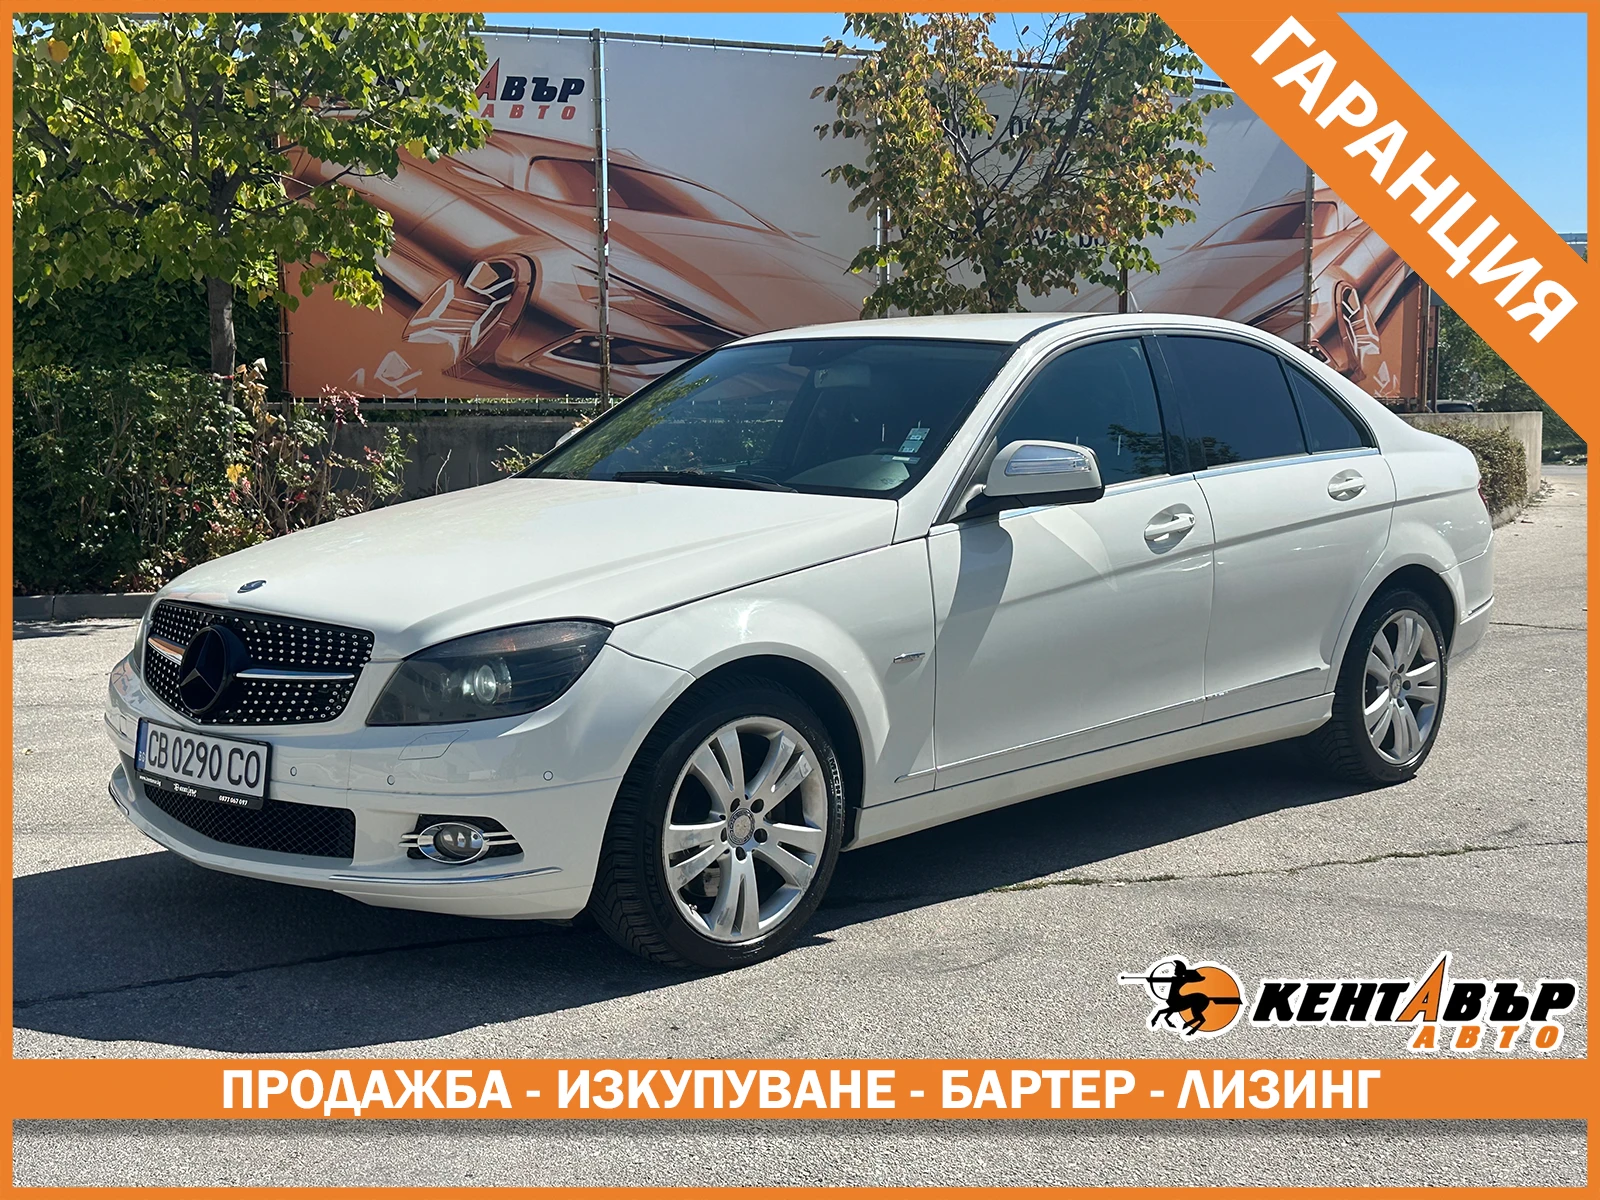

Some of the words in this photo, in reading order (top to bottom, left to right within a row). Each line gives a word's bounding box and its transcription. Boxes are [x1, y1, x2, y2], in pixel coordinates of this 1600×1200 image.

[481, 104, 576, 119] АВТО
[148, 730, 168, 768] CB
[172, 736, 222, 781] 0290
[227, 747, 260, 789] CO
